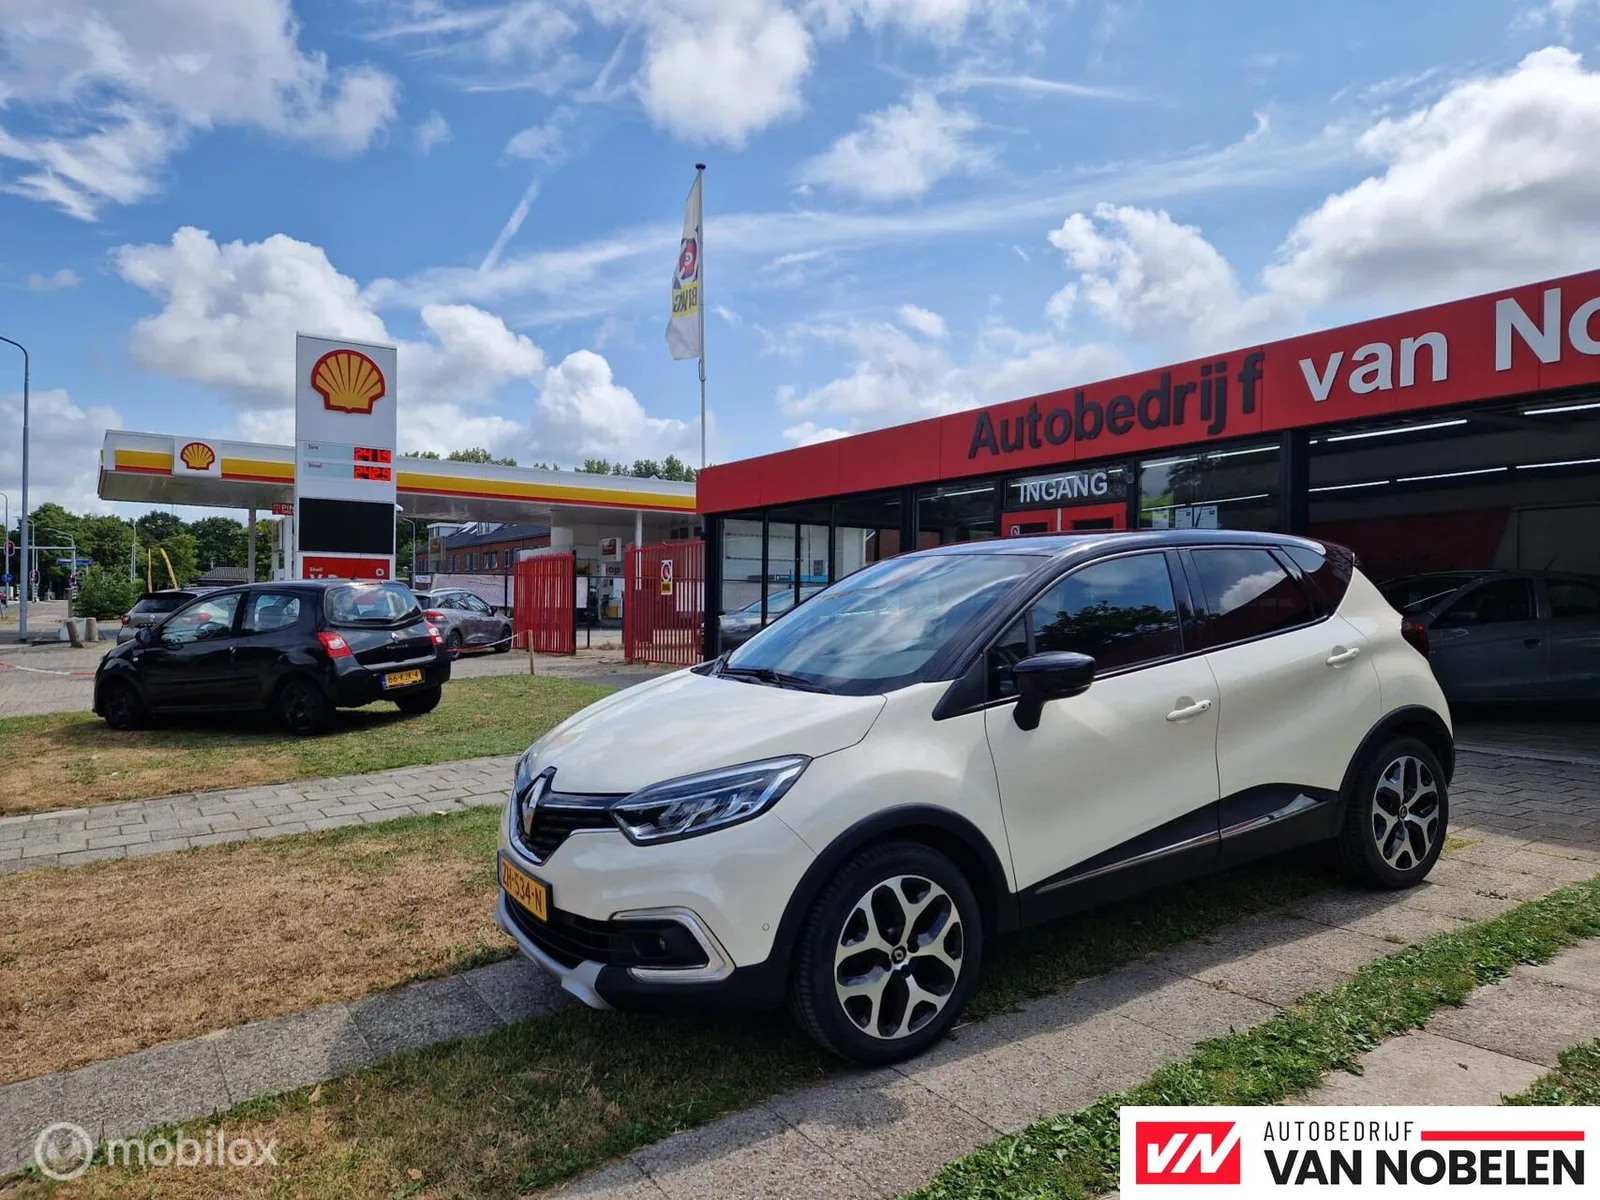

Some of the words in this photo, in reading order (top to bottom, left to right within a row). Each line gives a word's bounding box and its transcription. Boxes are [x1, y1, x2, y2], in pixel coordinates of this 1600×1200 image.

[968, 352, 1265, 459] Autobedrijf
[1299, 331, 1448, 402] van
[1020, 472, 1108, 503] INGANG
[503, 861, 542, 913] ZH-534-N
